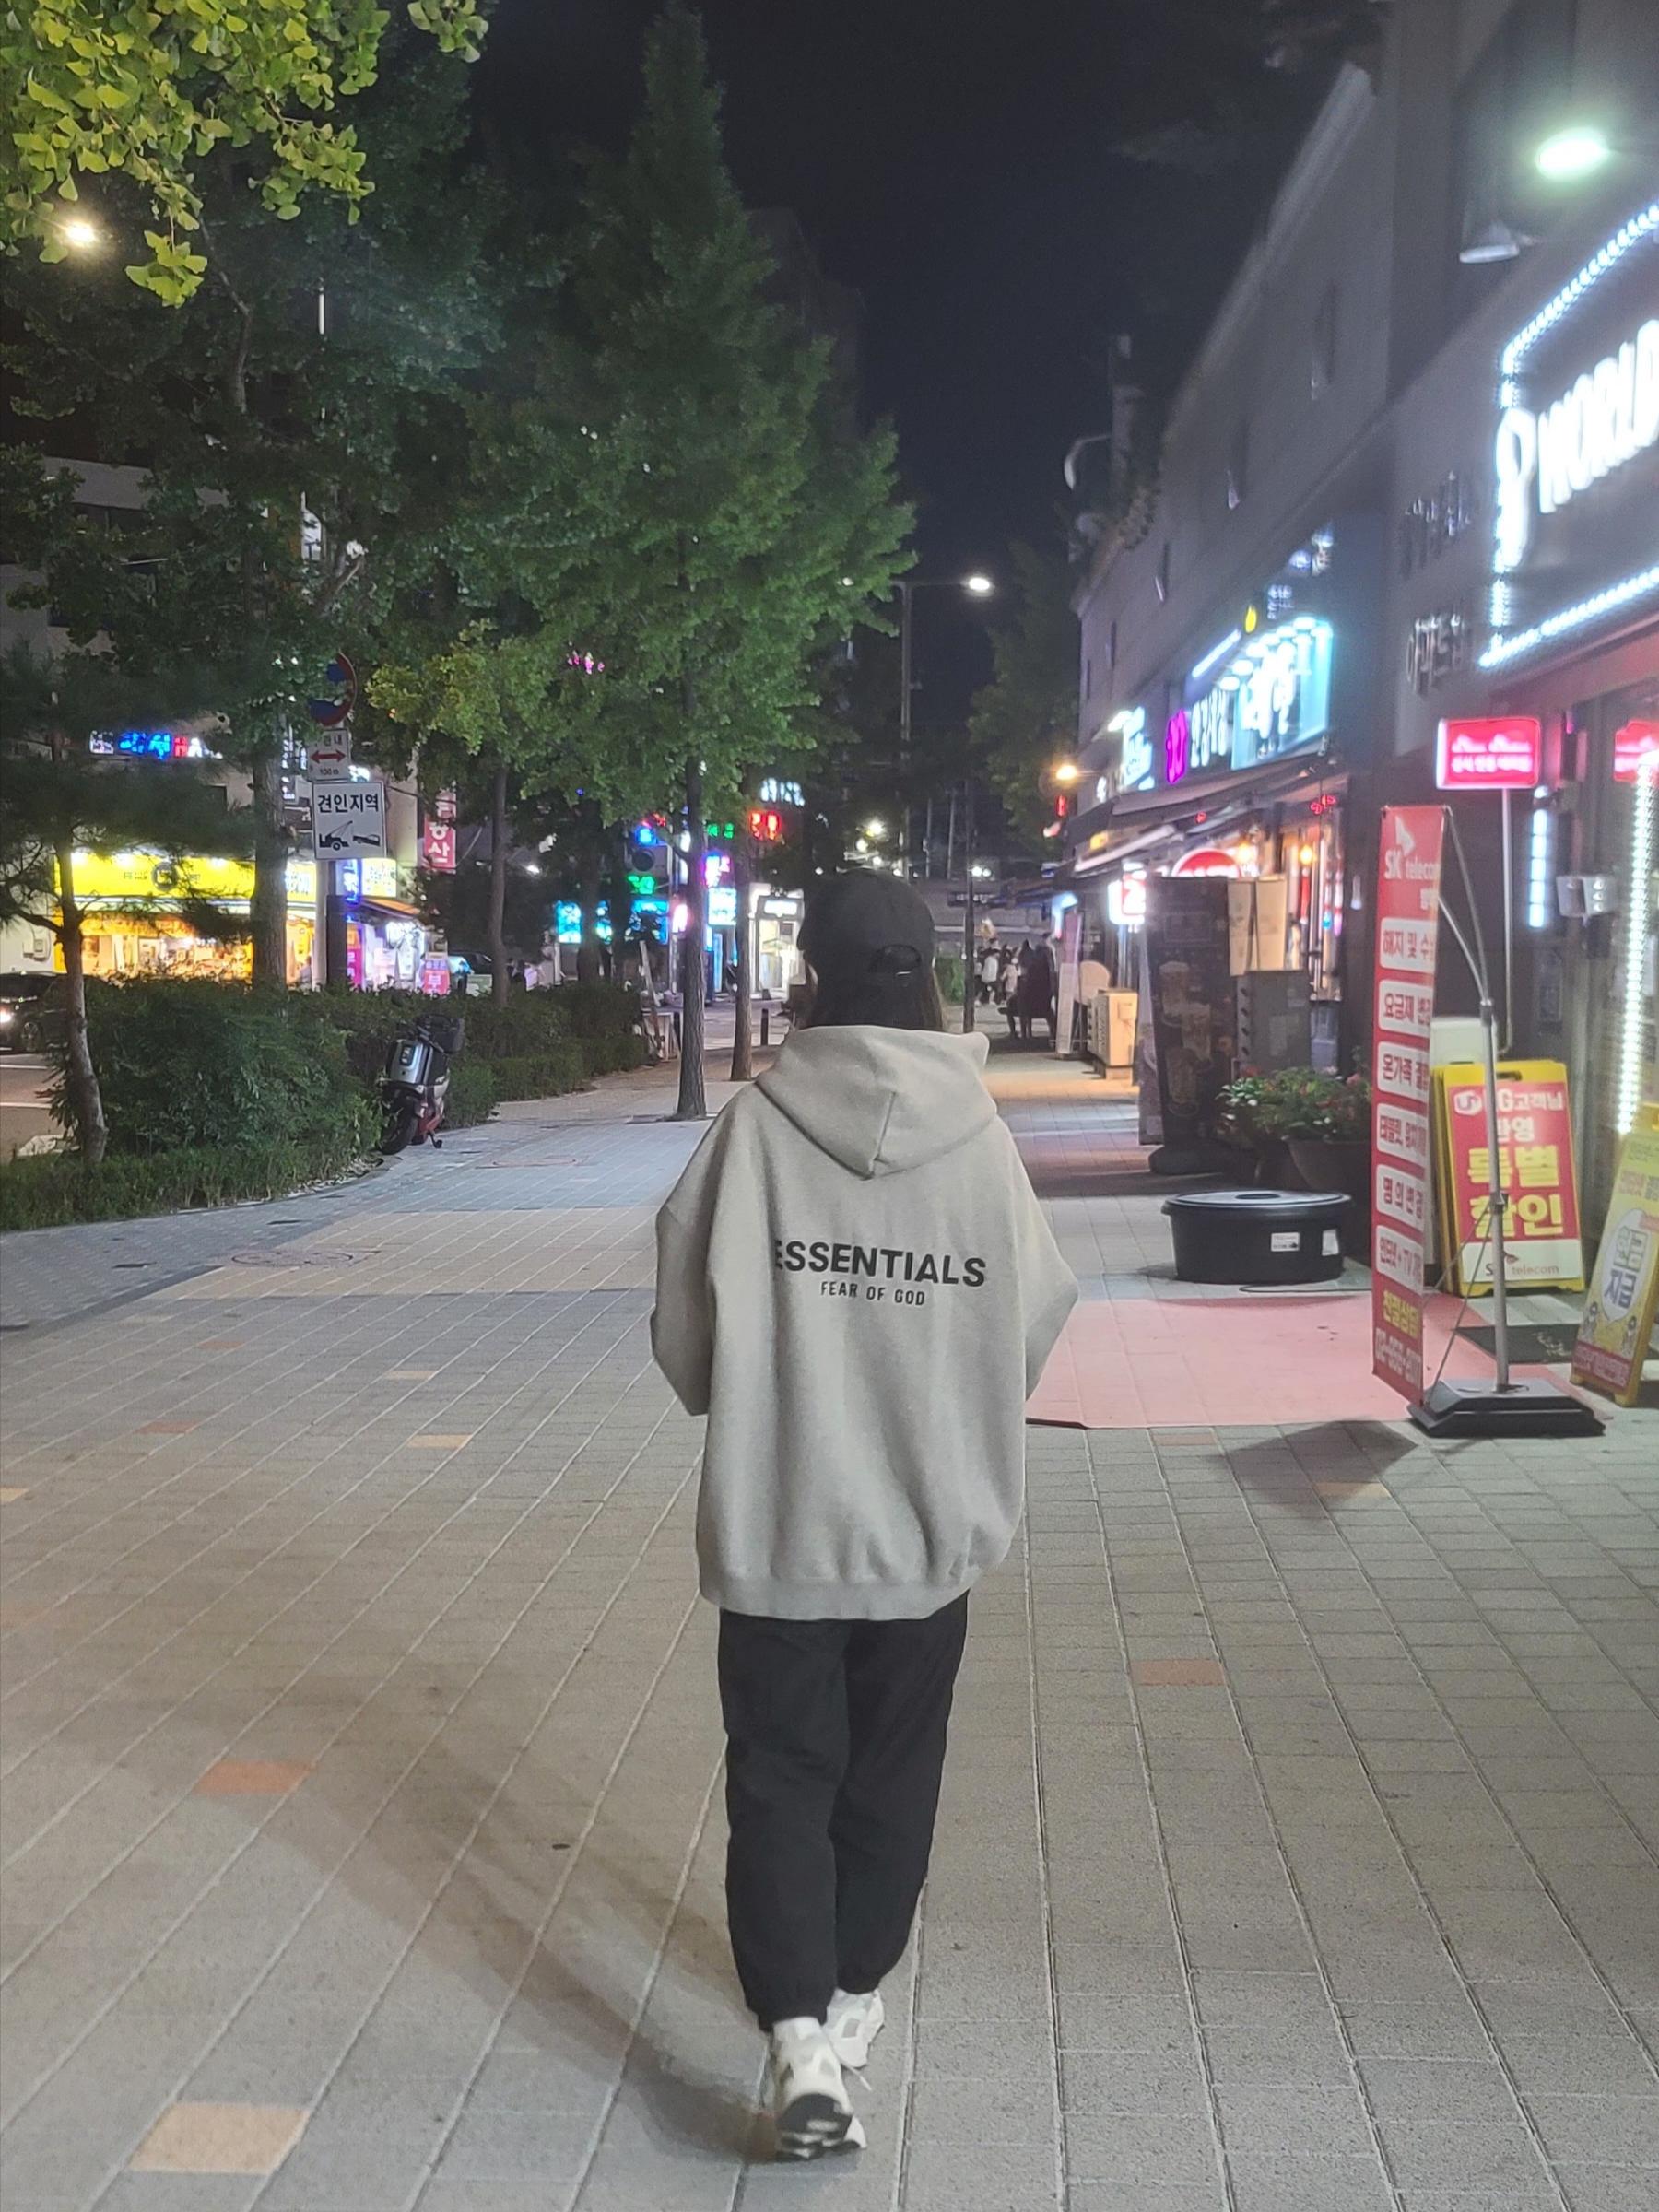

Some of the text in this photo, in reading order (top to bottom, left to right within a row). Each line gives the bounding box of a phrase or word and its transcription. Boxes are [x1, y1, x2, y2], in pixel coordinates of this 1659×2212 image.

[317, 793, 380, 814] 견인지역
[1384, 848, 1403, 880] SK
[1382, 929, 1404, 957] 해지
[1407, 931, 1418, 959] 및
[1383, 993, 1414, 1024] 요금제
[1382, 1053, 1412, 1086] 온가족
[1481, 1088, 1564, 1113] G고객님
[1467, 1145, 1559, 1188] 특별
[1469, 1194, 1564, 1239] 할인
[1512, 1265, 1560, 1277] telecom
[820, 1281, 925, 1307] FEAR OF GOD
